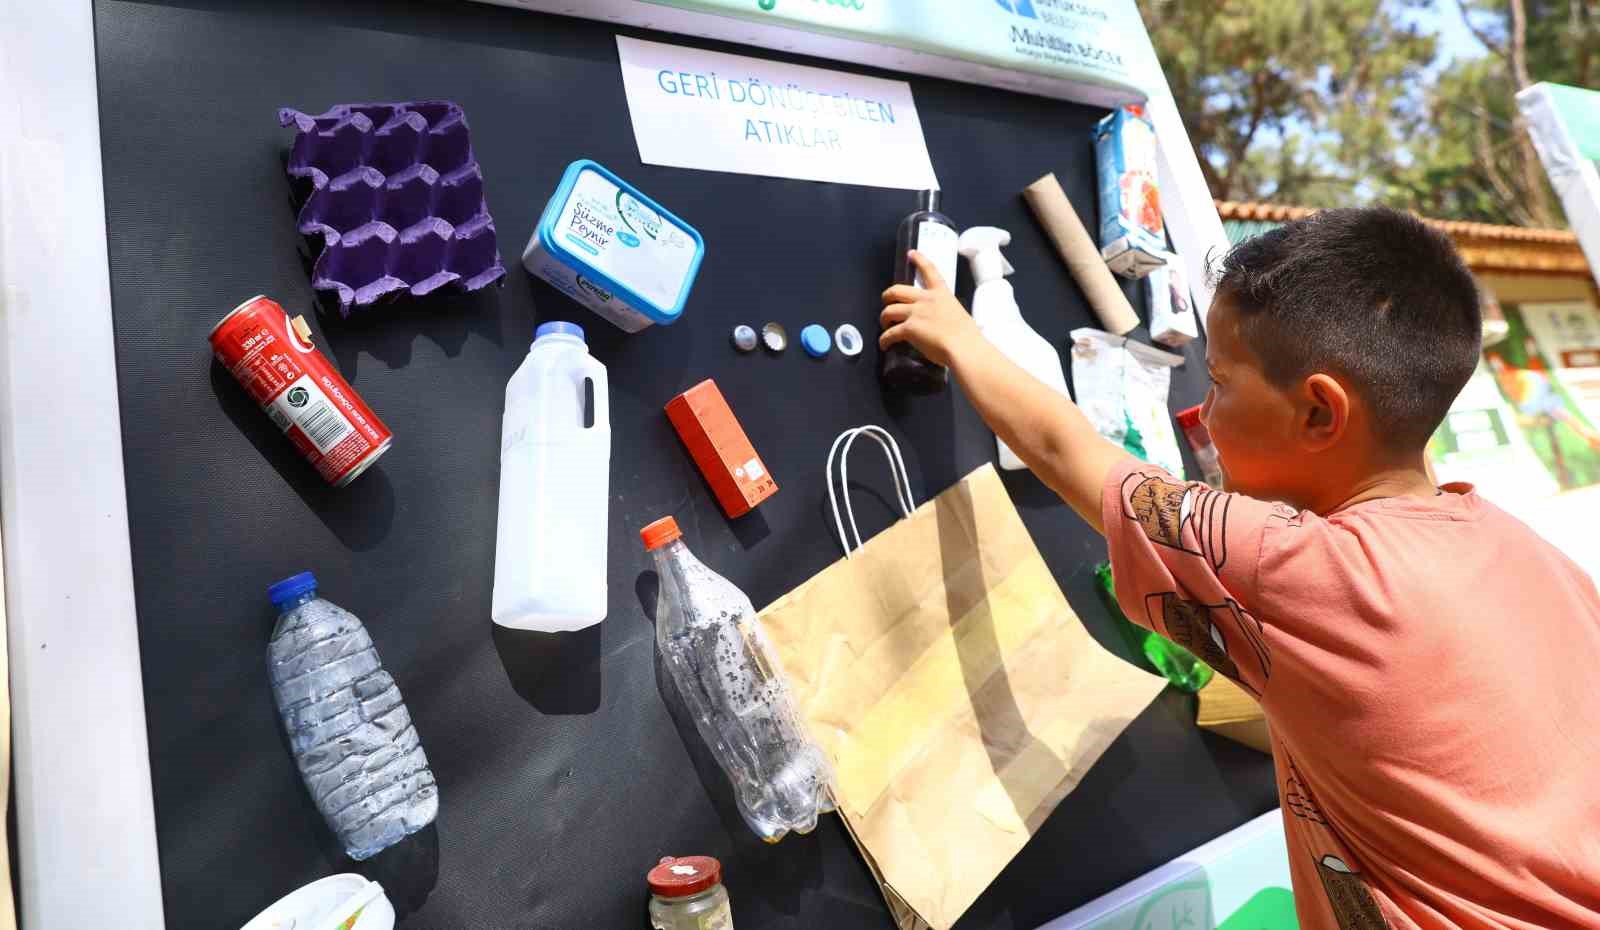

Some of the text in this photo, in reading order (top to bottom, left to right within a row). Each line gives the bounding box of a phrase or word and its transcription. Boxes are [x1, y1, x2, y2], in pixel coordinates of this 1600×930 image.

[657, 69, 896, 125] GERİ DÖNÜŞEBİLEN
[744, 119, 842, 151] ATIKLAR
[570, 214, 609, 246] Peynir
[573, 201, 614, 237] Süzme
